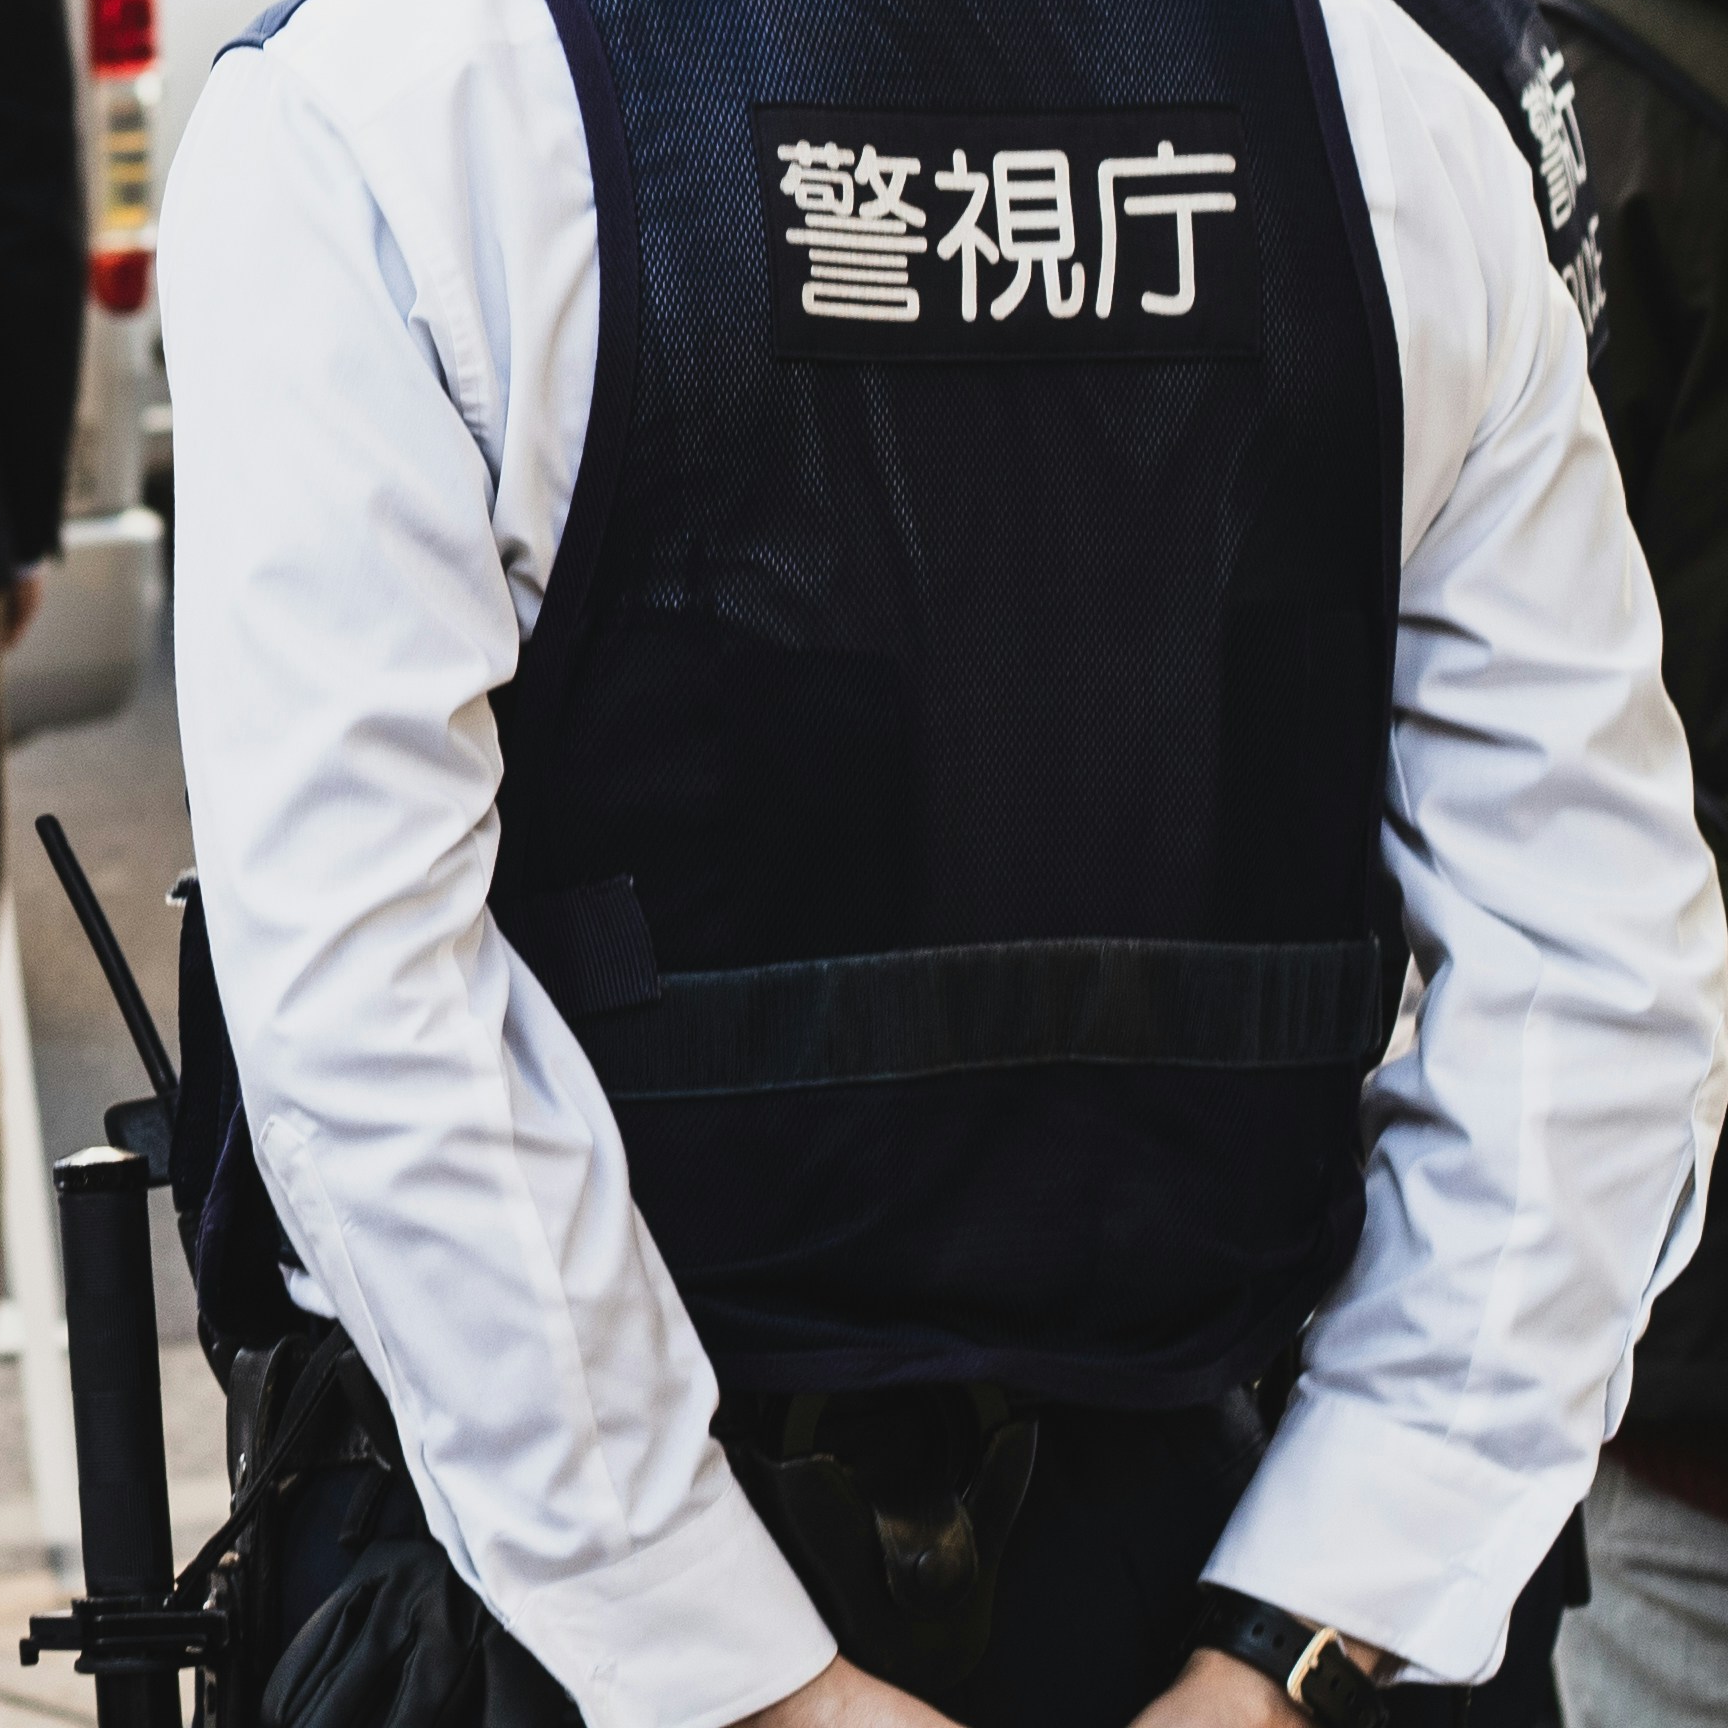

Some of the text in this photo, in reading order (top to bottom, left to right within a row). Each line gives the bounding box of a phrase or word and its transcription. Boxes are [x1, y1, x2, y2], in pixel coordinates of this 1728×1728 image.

[1520, 44, 1588, 230] 警庁
[777, 139, 1238, 323] 警視庁
